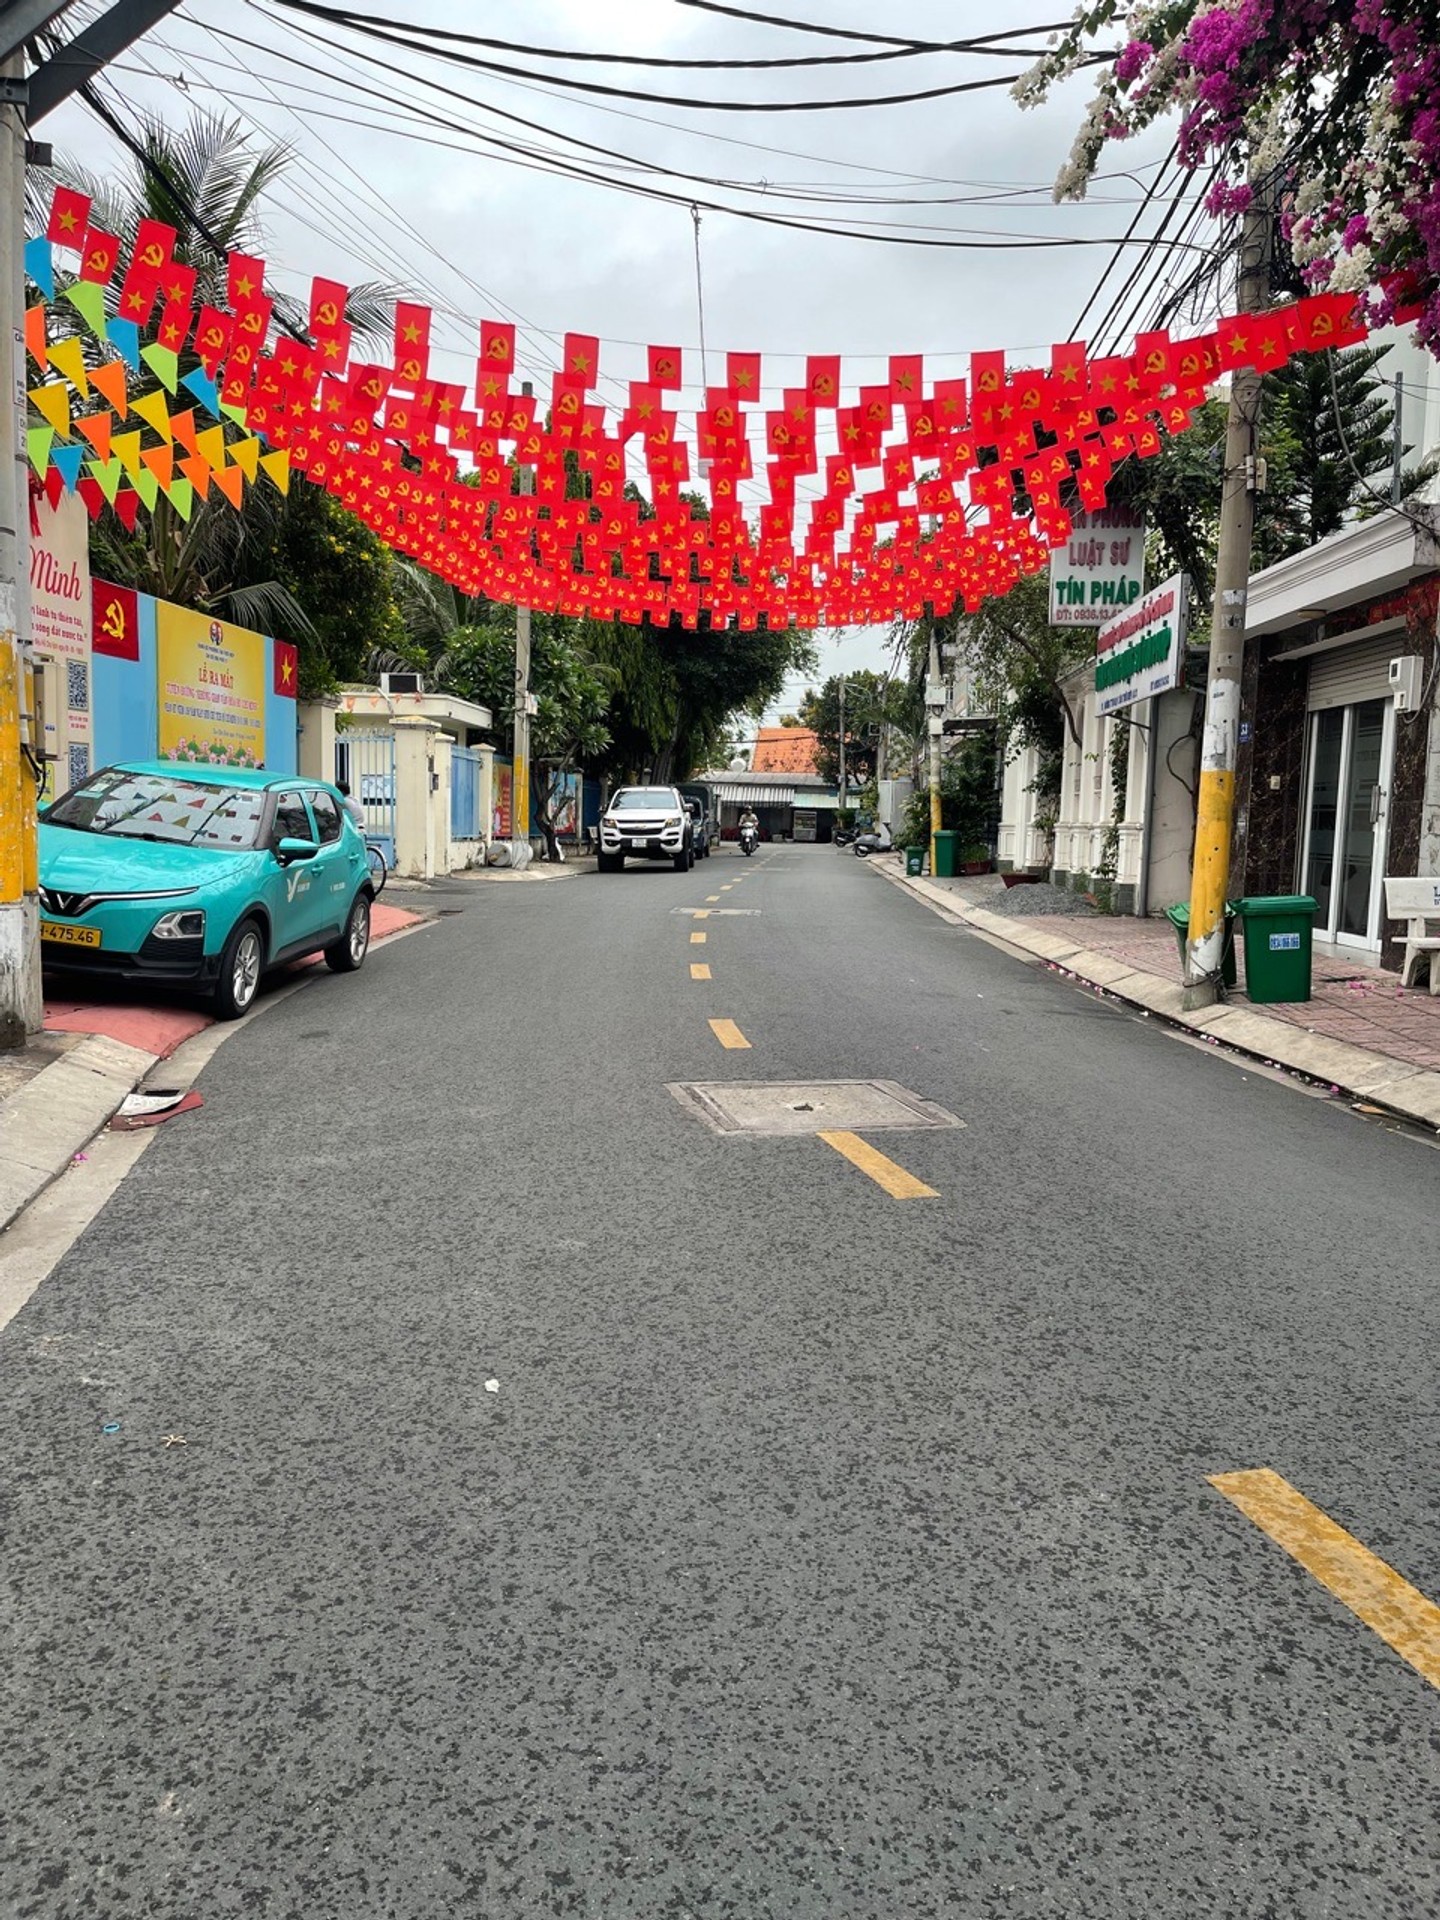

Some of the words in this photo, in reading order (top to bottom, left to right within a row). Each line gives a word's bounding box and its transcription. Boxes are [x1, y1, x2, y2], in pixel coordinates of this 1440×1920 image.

[1068, 537, 1105, 571] LUẬT
[1110, 537, 1131, 567] SƯ
[29, 545, 83, 602] Minh
[1056, 574, 1085, 605] TÍN
[1090, 574, 1140, 605] PHÁP
[1056, 608, 1072, 621] ĐT:
